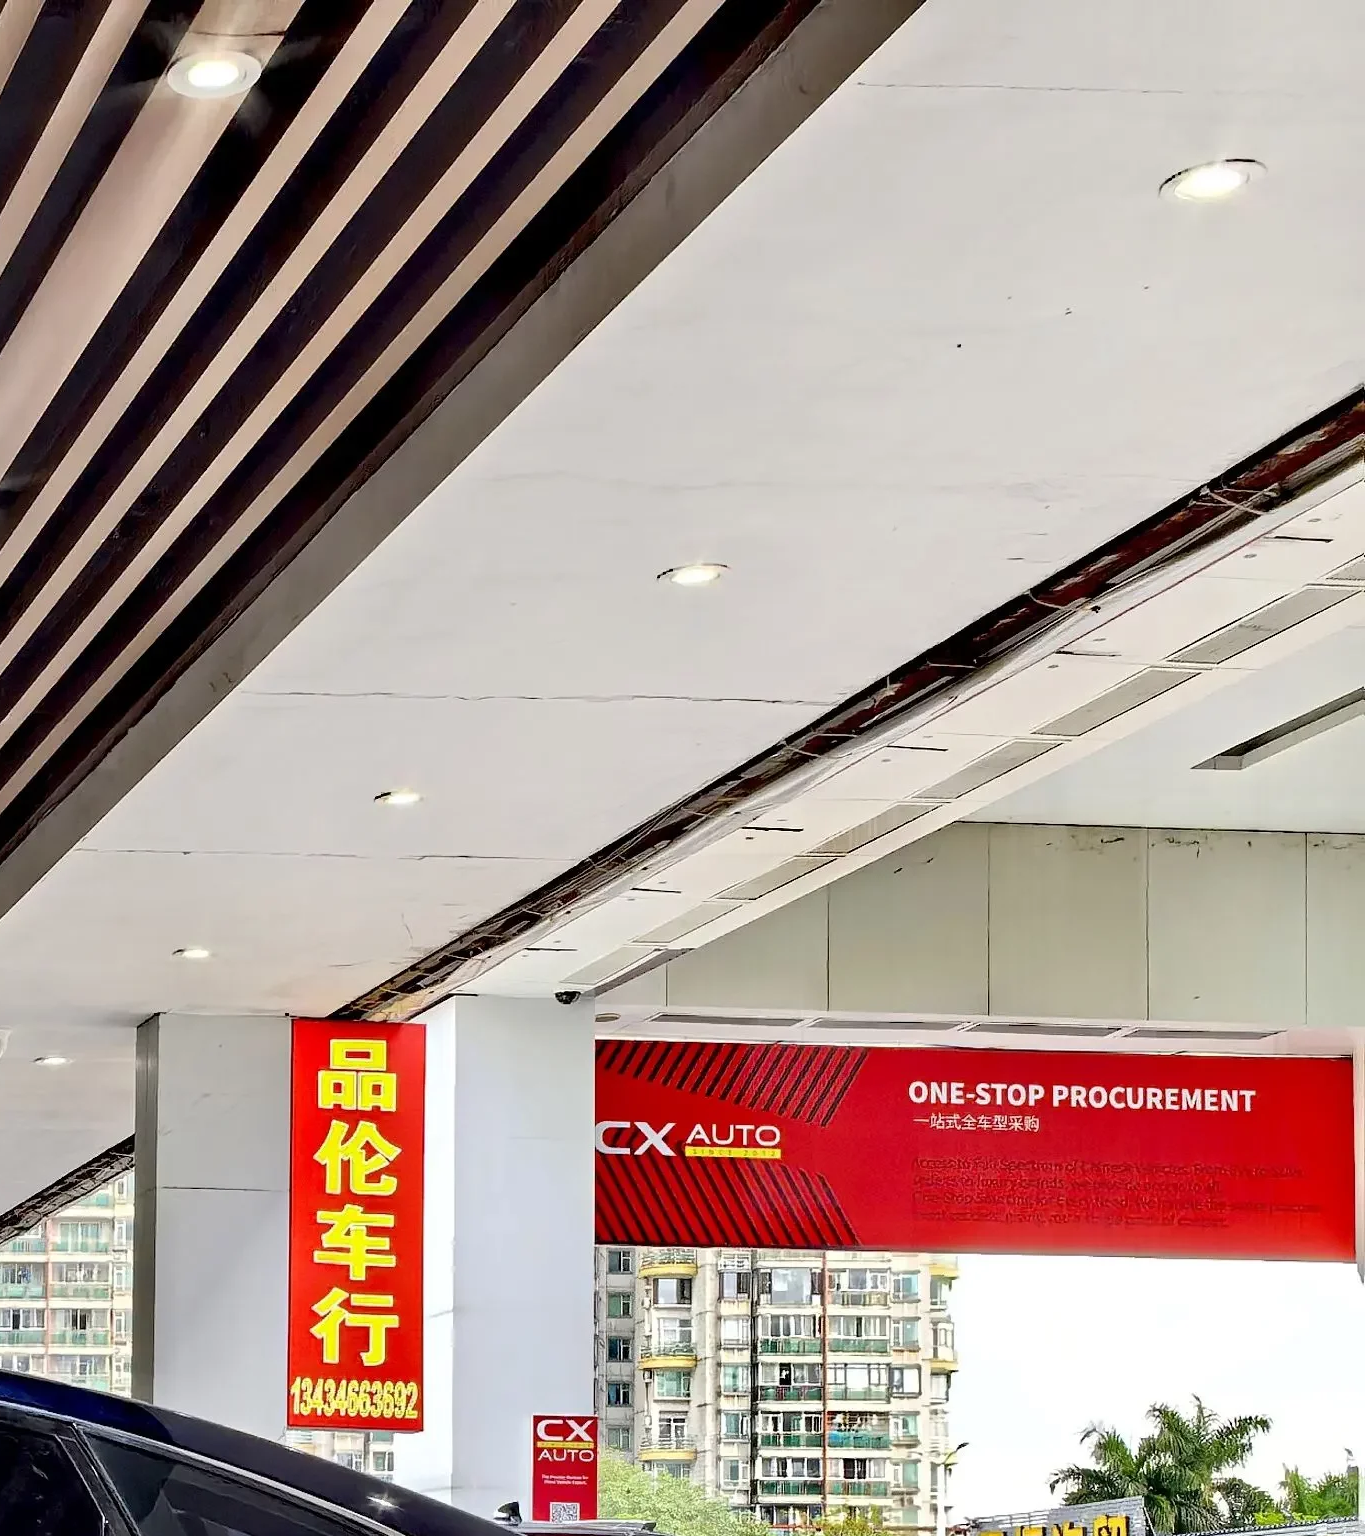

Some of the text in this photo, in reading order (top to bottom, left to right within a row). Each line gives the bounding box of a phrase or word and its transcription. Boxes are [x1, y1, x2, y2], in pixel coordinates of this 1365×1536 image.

[908, 1080, 1256, 1112] ONE-STOP PROCUREMENT
[595, 1120, 781, 1156] CX AUTO
[913, 1112, 1040, 1133] 一站式全车型采购
[310, 1038, 402, 1367] 品伦车行
[290, 1376, 418, 1419] 13434663692
[536, 1419, 594, 1442] CX
[537, 1449, 595, 1462] AUTO
